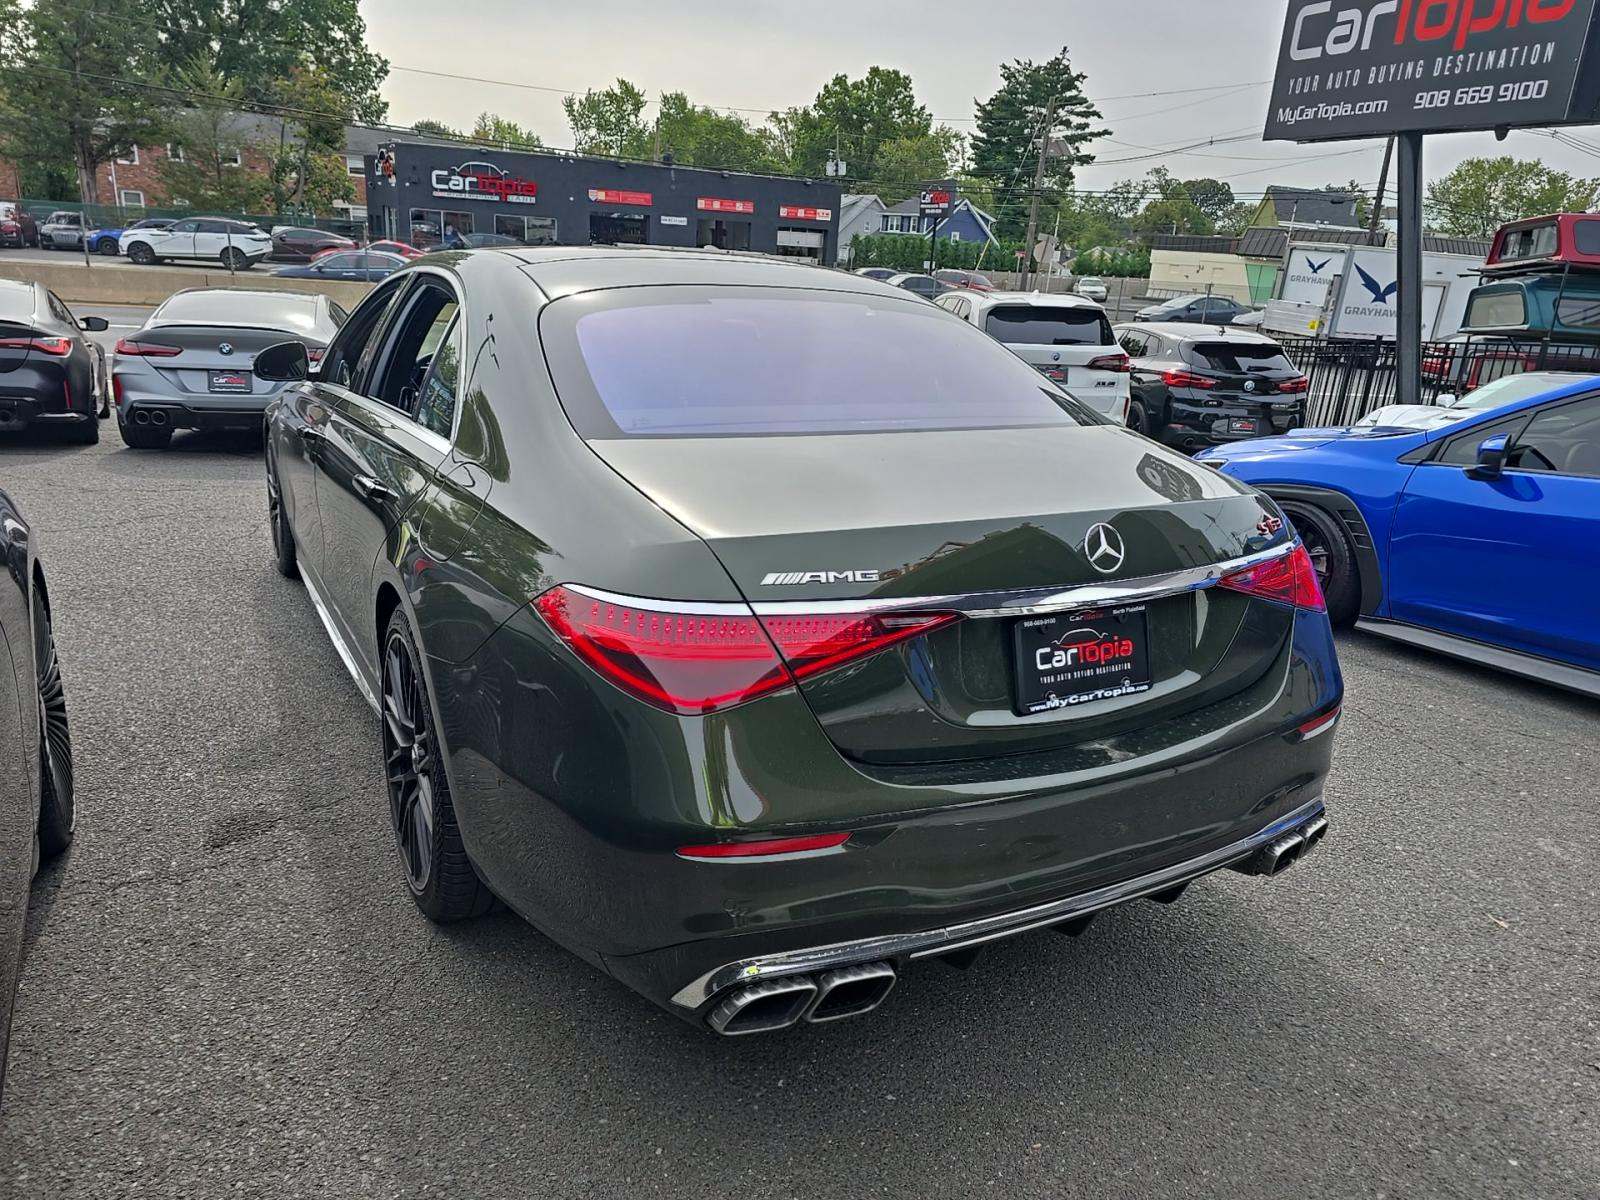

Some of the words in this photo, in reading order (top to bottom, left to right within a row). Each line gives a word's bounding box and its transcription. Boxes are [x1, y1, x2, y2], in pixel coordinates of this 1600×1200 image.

[1288, 74, 1319, 95] YOUR
[1326, 68, 1360, 87] AUTO
[1368, 59, 1424, 85] BUYING
[1433, 42, 1555, 77] DESTINATION
[1276, 99, 1388, 125] MyCarTopia.com
[1413, 89, 1450, 110] 908
[1454, 85, 1493, 107] 669
[1497, 79, 1549, 102] 9100
[1290, 274, 1332, 285] GRAYHAW
[1344, 306, 1397, 317] GRAYHAW
[798, 569, 880, 584] AMG
[1036, 636, 1132, 669] CarTopia
[1029, 685, 1149, 711] www.MyCarTopia.com
